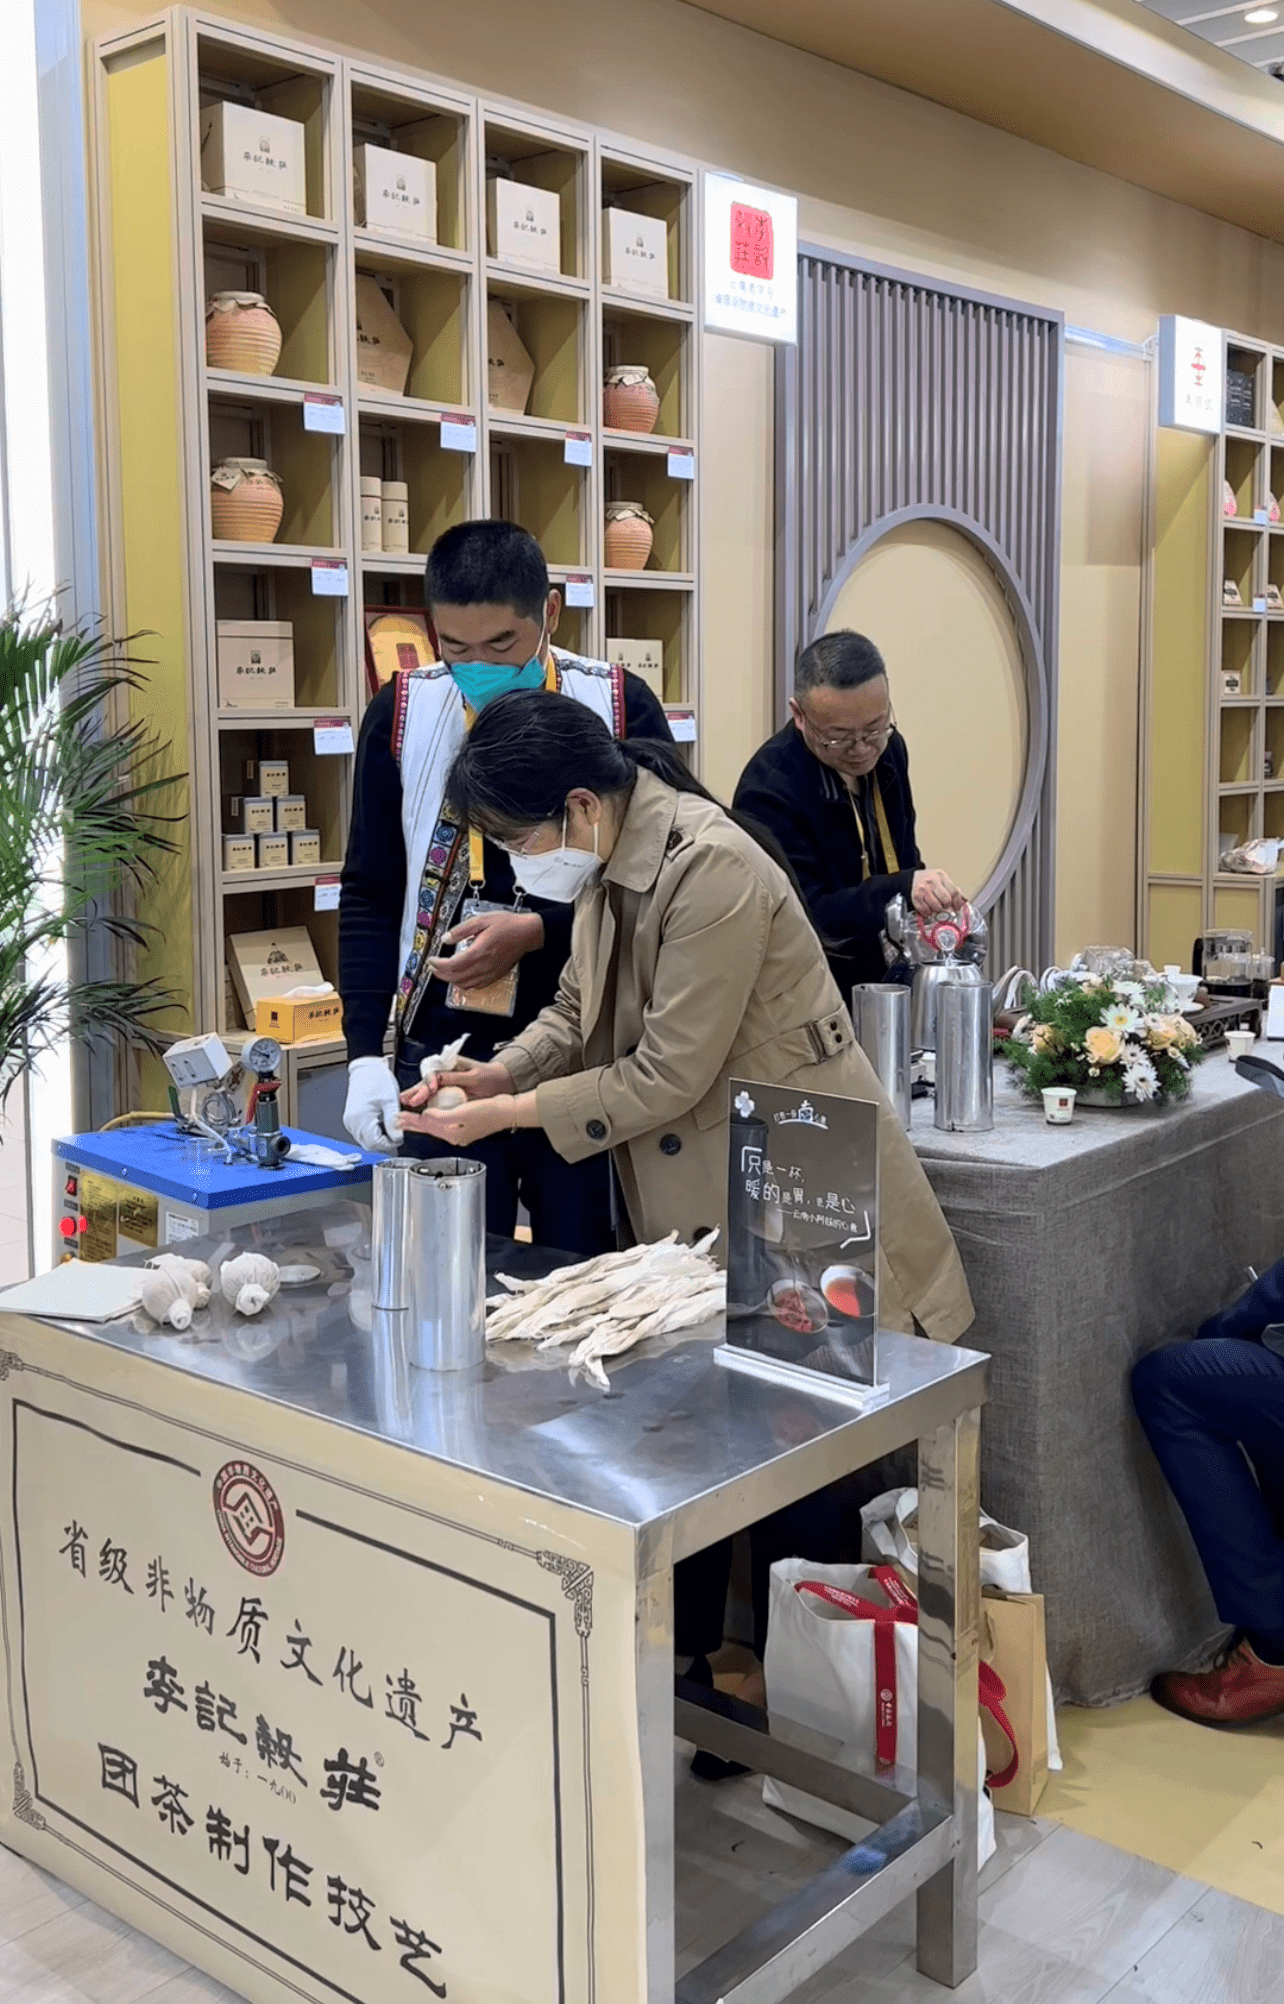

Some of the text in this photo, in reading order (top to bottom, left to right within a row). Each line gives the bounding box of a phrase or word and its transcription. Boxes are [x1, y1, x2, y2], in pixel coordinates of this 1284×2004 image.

[58, 1520, 484, 1750] 省级非物质文化遗产
[97, 1741, 448, 1999] 团茶制作技艺
